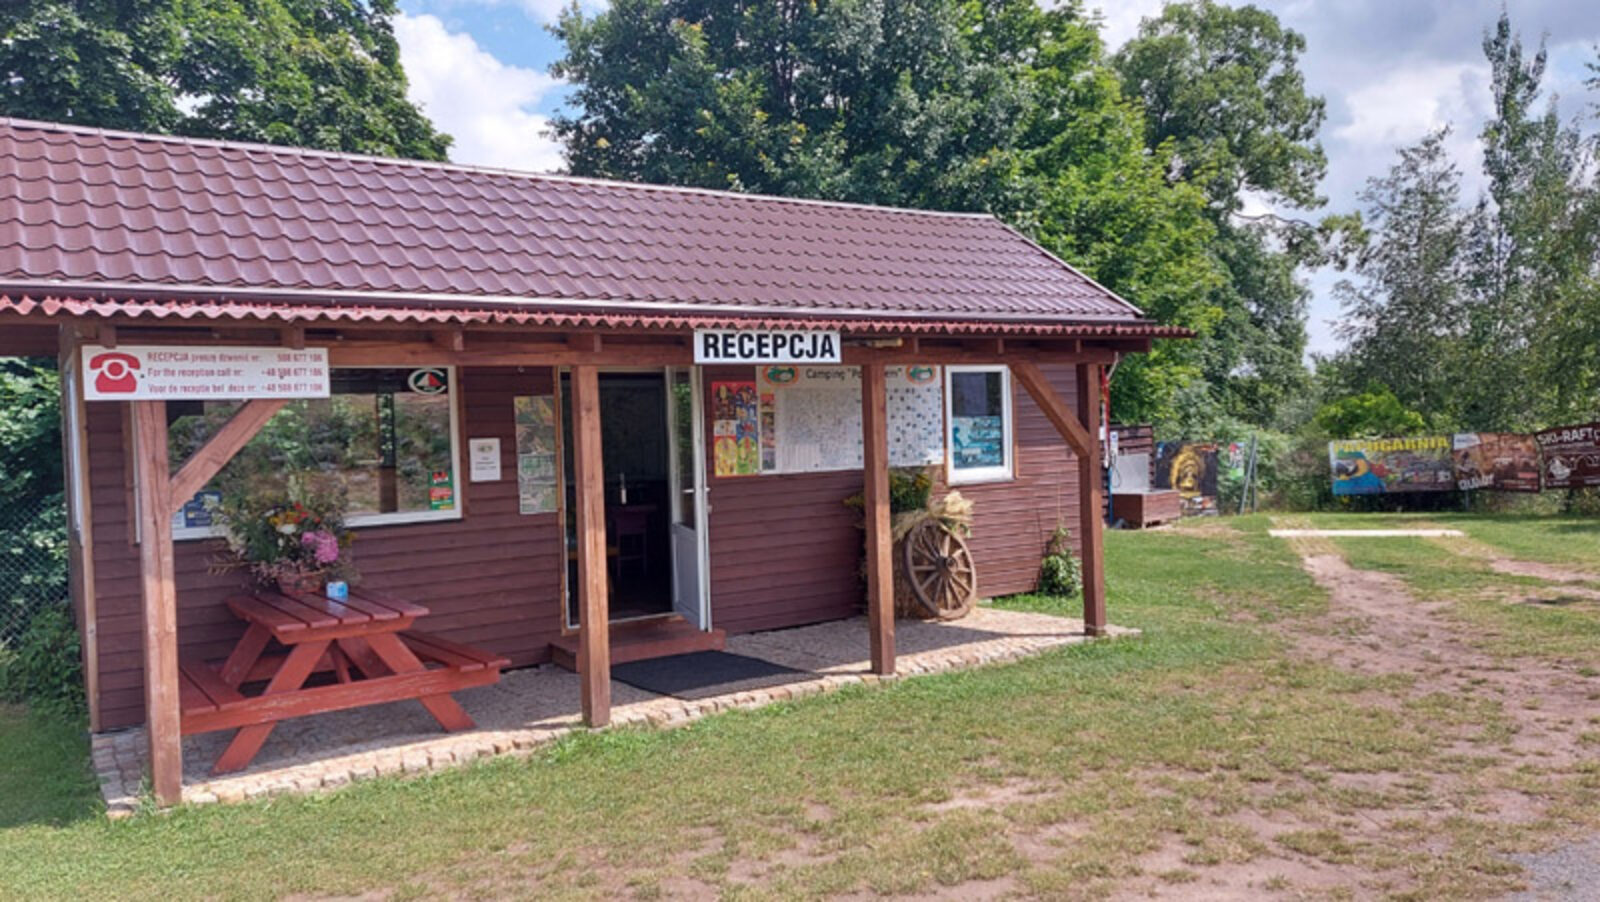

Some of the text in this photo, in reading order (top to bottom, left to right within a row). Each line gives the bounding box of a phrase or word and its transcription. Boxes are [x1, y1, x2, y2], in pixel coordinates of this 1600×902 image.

[703, 333, 835, 359] RECEPCJA
[147, 352, 189, 362] RECEPCJA
[147, 368, 161, 377] For
[163, 368, 176, 377] the
[178, 369, 215, 378] reception
[805, 367, 846, 381] Camping
